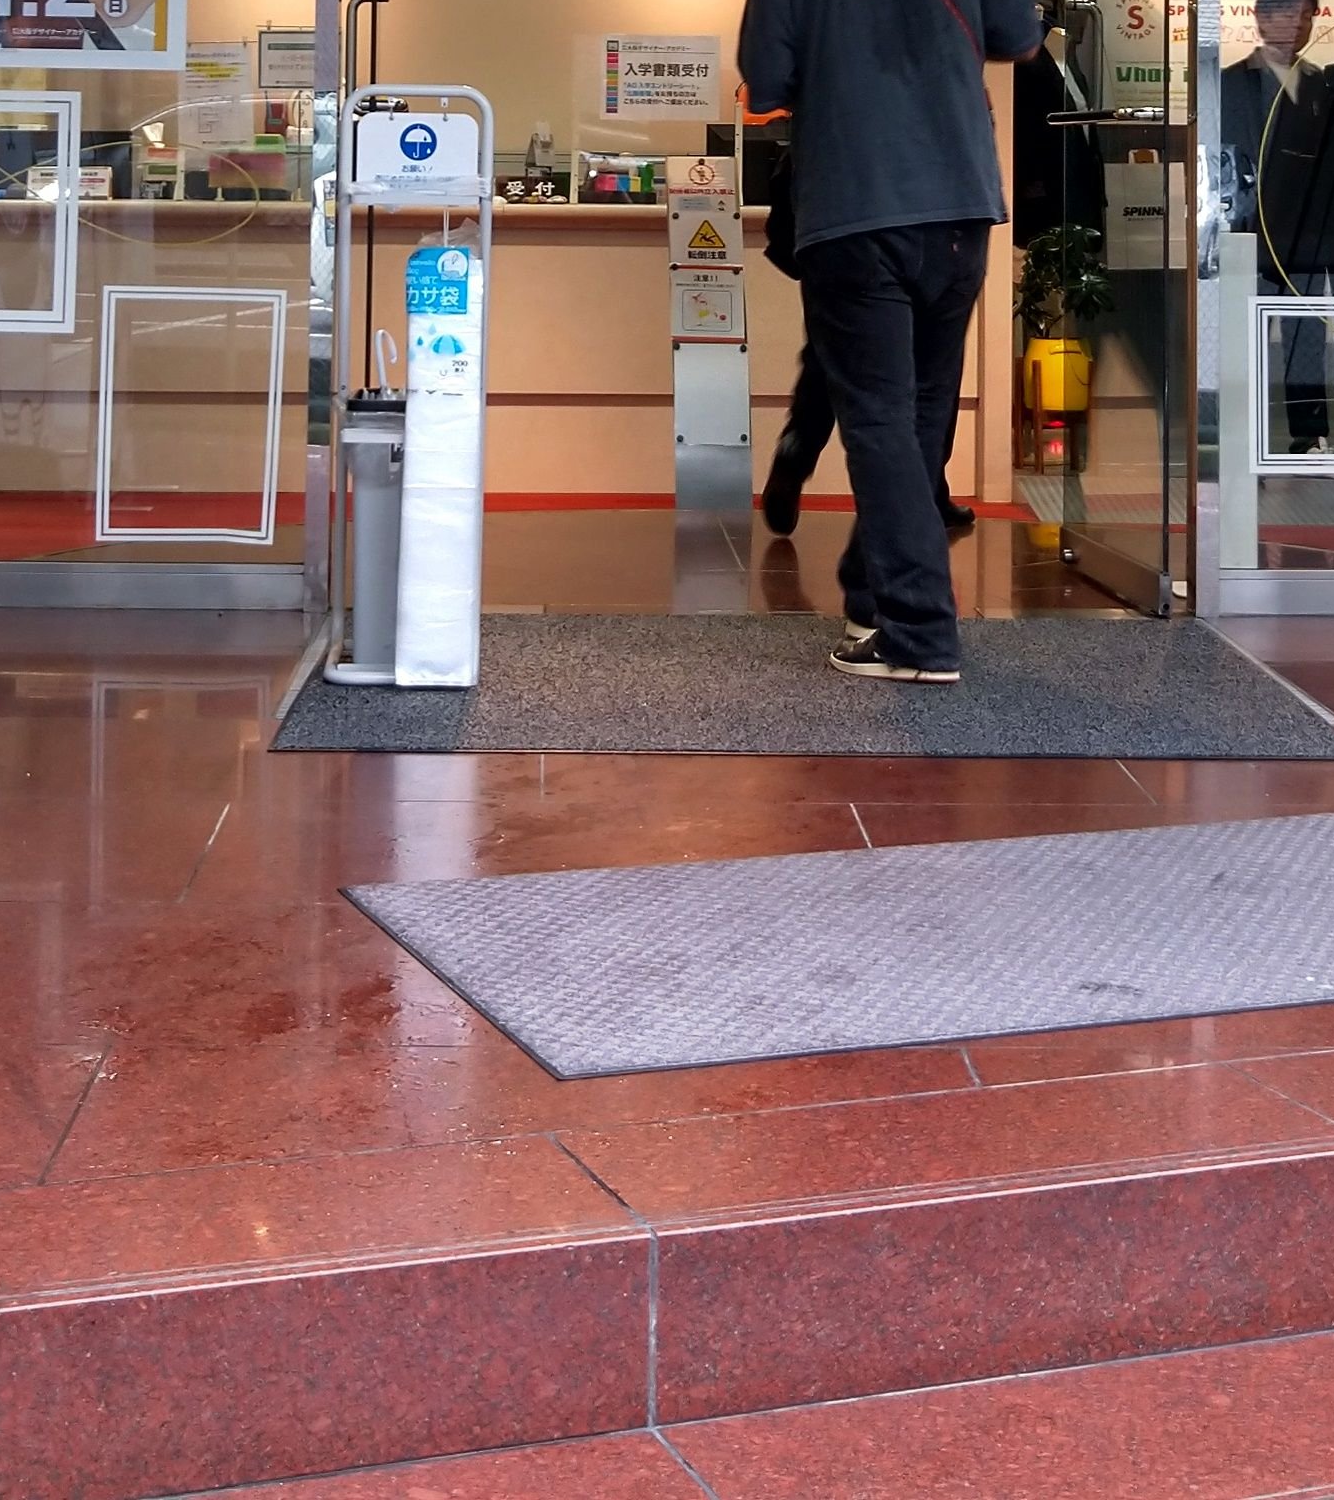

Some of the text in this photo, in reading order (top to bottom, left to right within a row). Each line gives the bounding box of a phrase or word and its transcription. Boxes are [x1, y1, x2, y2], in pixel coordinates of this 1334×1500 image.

[624, 63, 710, 78] 入学書類受付
[687, 250, 727, 260] 転倒注意
[407, 286, 460, 307] カサ袋
